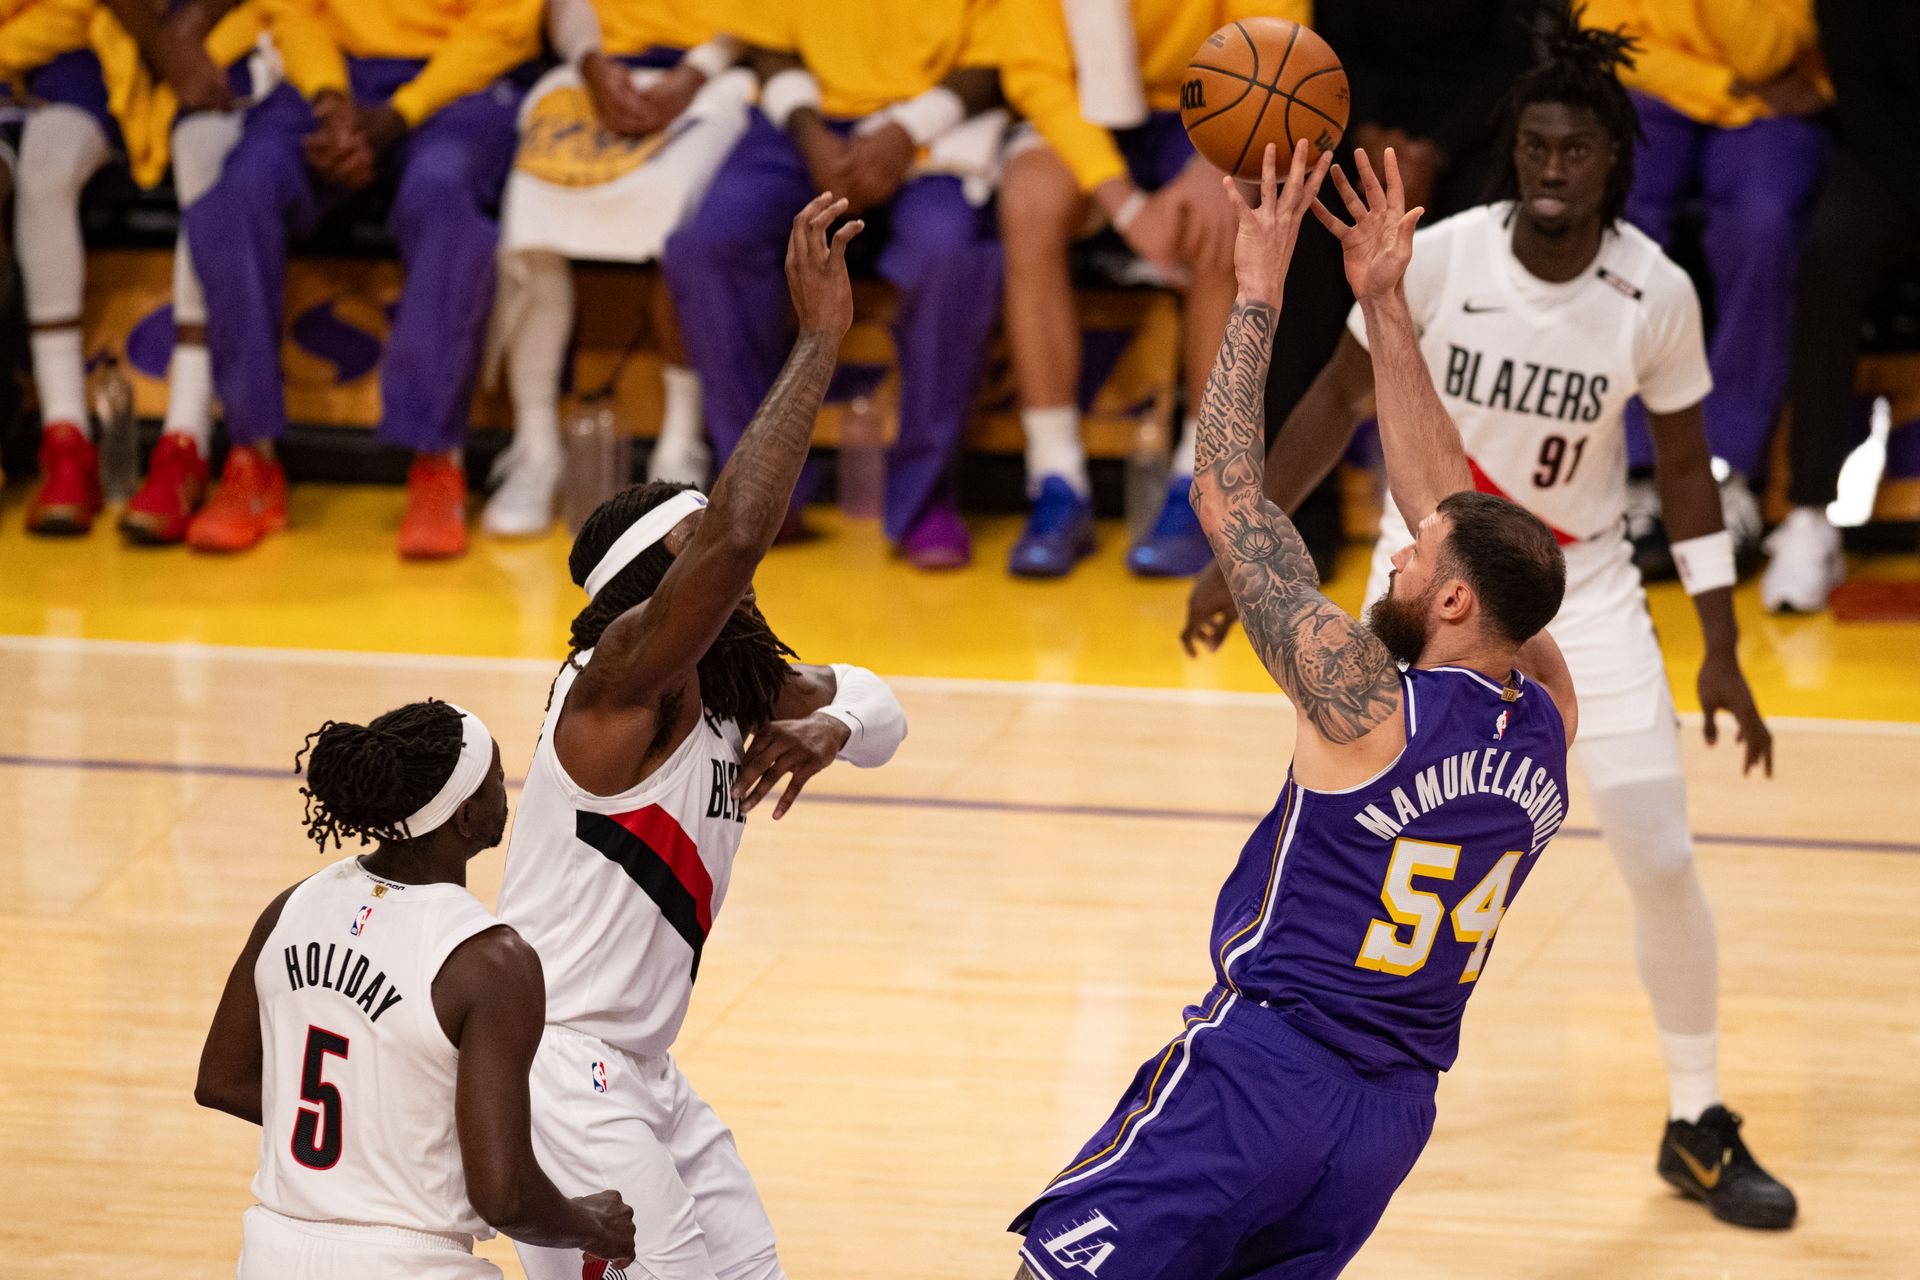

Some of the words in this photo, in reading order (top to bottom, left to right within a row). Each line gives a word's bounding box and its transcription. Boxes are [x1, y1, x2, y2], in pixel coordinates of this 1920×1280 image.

[1445, 344, 1608, 422] BLAZERS
[1533, 435, 1588, 488] 91
[1354, 837, 1524, 985] 54
[284, 942, 402, 1023] HOLIDAY
[290, 1024, 349, 1170] 5
[1039, 1208, 1118, 1278] LA
